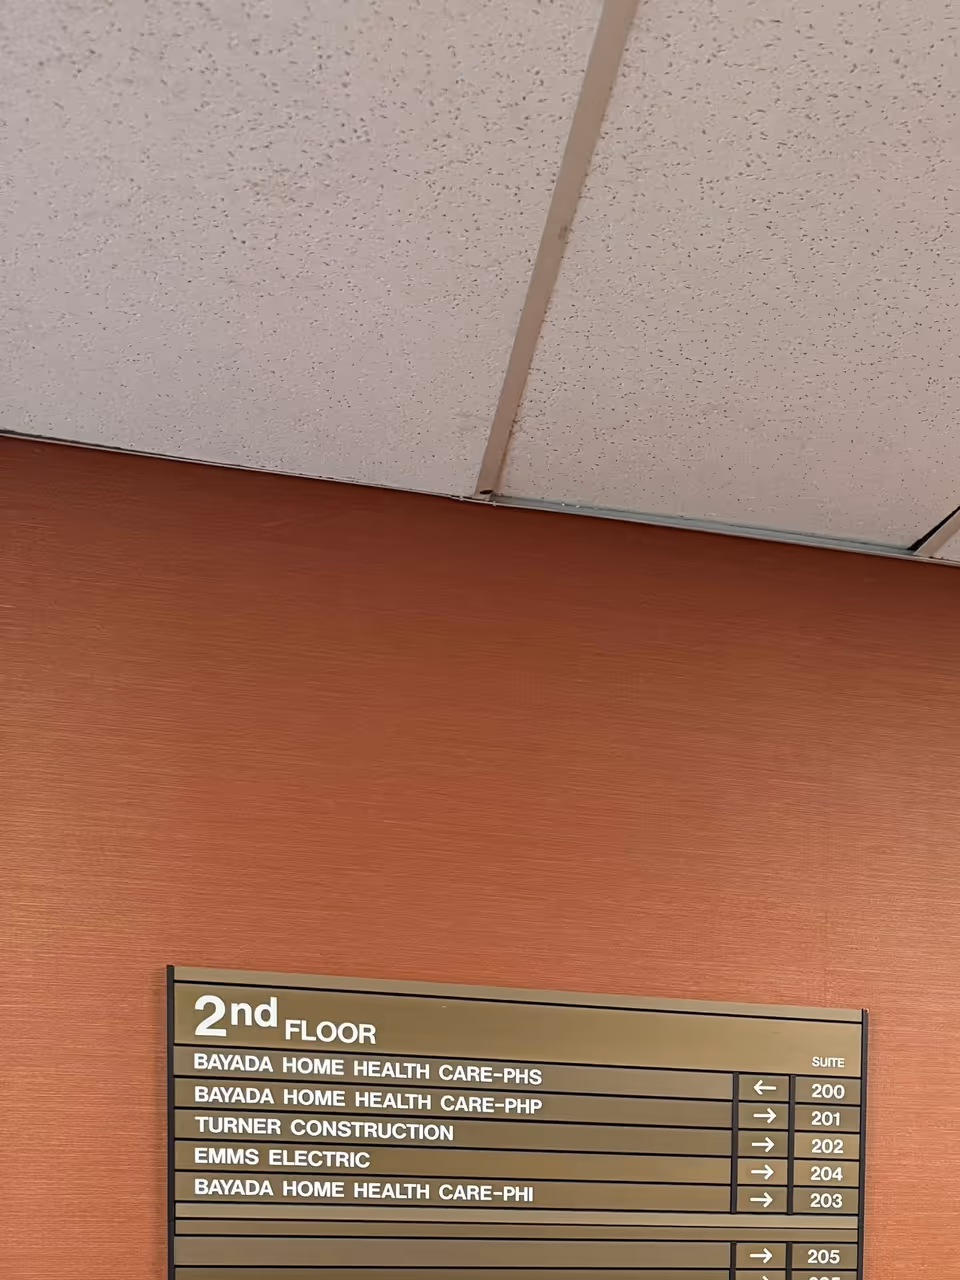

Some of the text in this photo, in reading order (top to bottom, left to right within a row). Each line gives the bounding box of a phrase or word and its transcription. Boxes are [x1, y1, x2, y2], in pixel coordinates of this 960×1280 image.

[195, 995, 375, 1044] 2nd FLOOR
[194, 1053, 542, 1084] BAYADA HOME HEALTH CARE-PHS
[812, 1056, 845, 1067] SUITE
[812, 1084, 844, 1099] 200
[195, 1086, 542, 1113] BAYADA HOME HEALTH CARE-PHP
[812, 1111, 839, 1126] 201
[195, 1117, 453, 1140] TURNER CONSTRUCTION
[812, 1139, 843, 1153] 202
[195, 1148, 370, 1168] EMMS ELECTRIC
[811, 1166, 843, 1181] 204
[195, 1179, 533, 1201] BAYADA HOME HEALTH CARE-PHI
[811, 1193, 842, 1208] 203
[808, 1249, 839, 1263] 205
